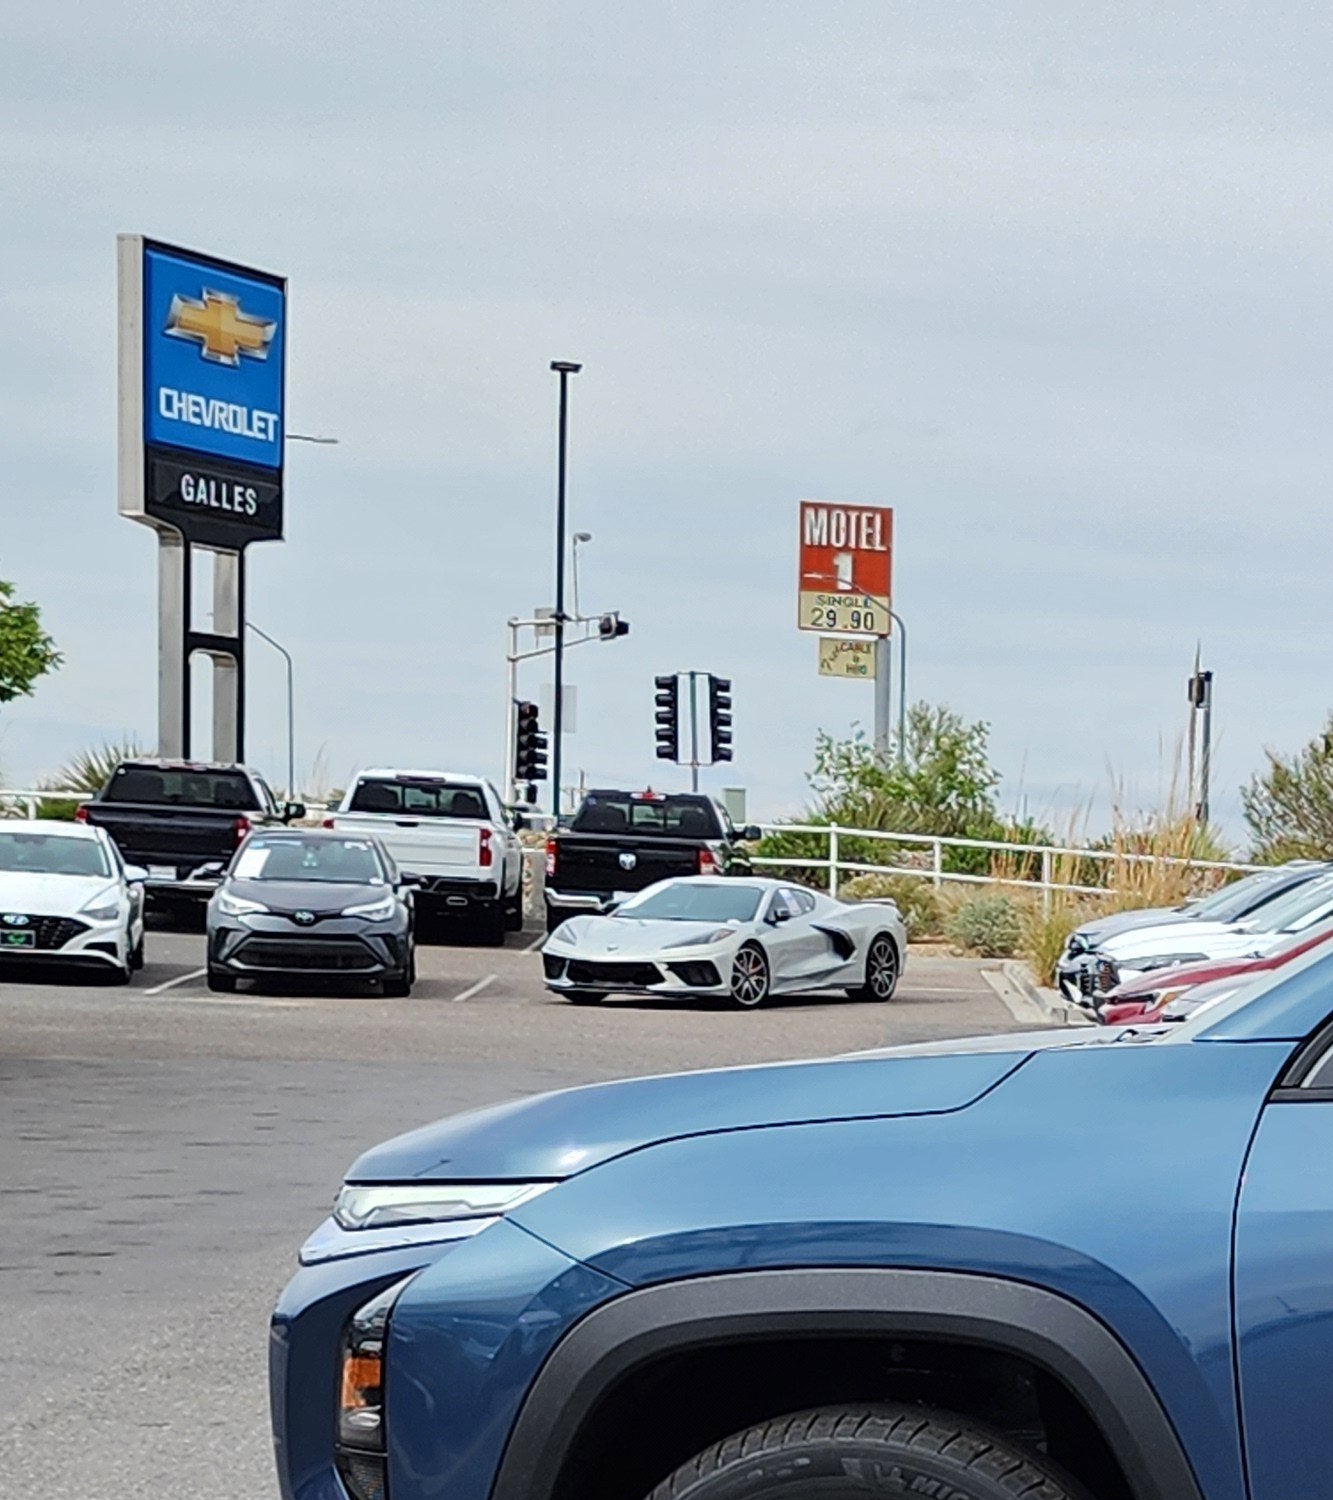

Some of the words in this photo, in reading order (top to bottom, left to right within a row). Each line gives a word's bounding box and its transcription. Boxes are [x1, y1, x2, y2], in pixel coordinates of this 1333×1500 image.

[159, 386, 279, 442] CHEVROLET
[180, 473, 258, 516] GALLES
[803, 506, 888, 551] MOTEL
[833, 552, 853, 591] 1
